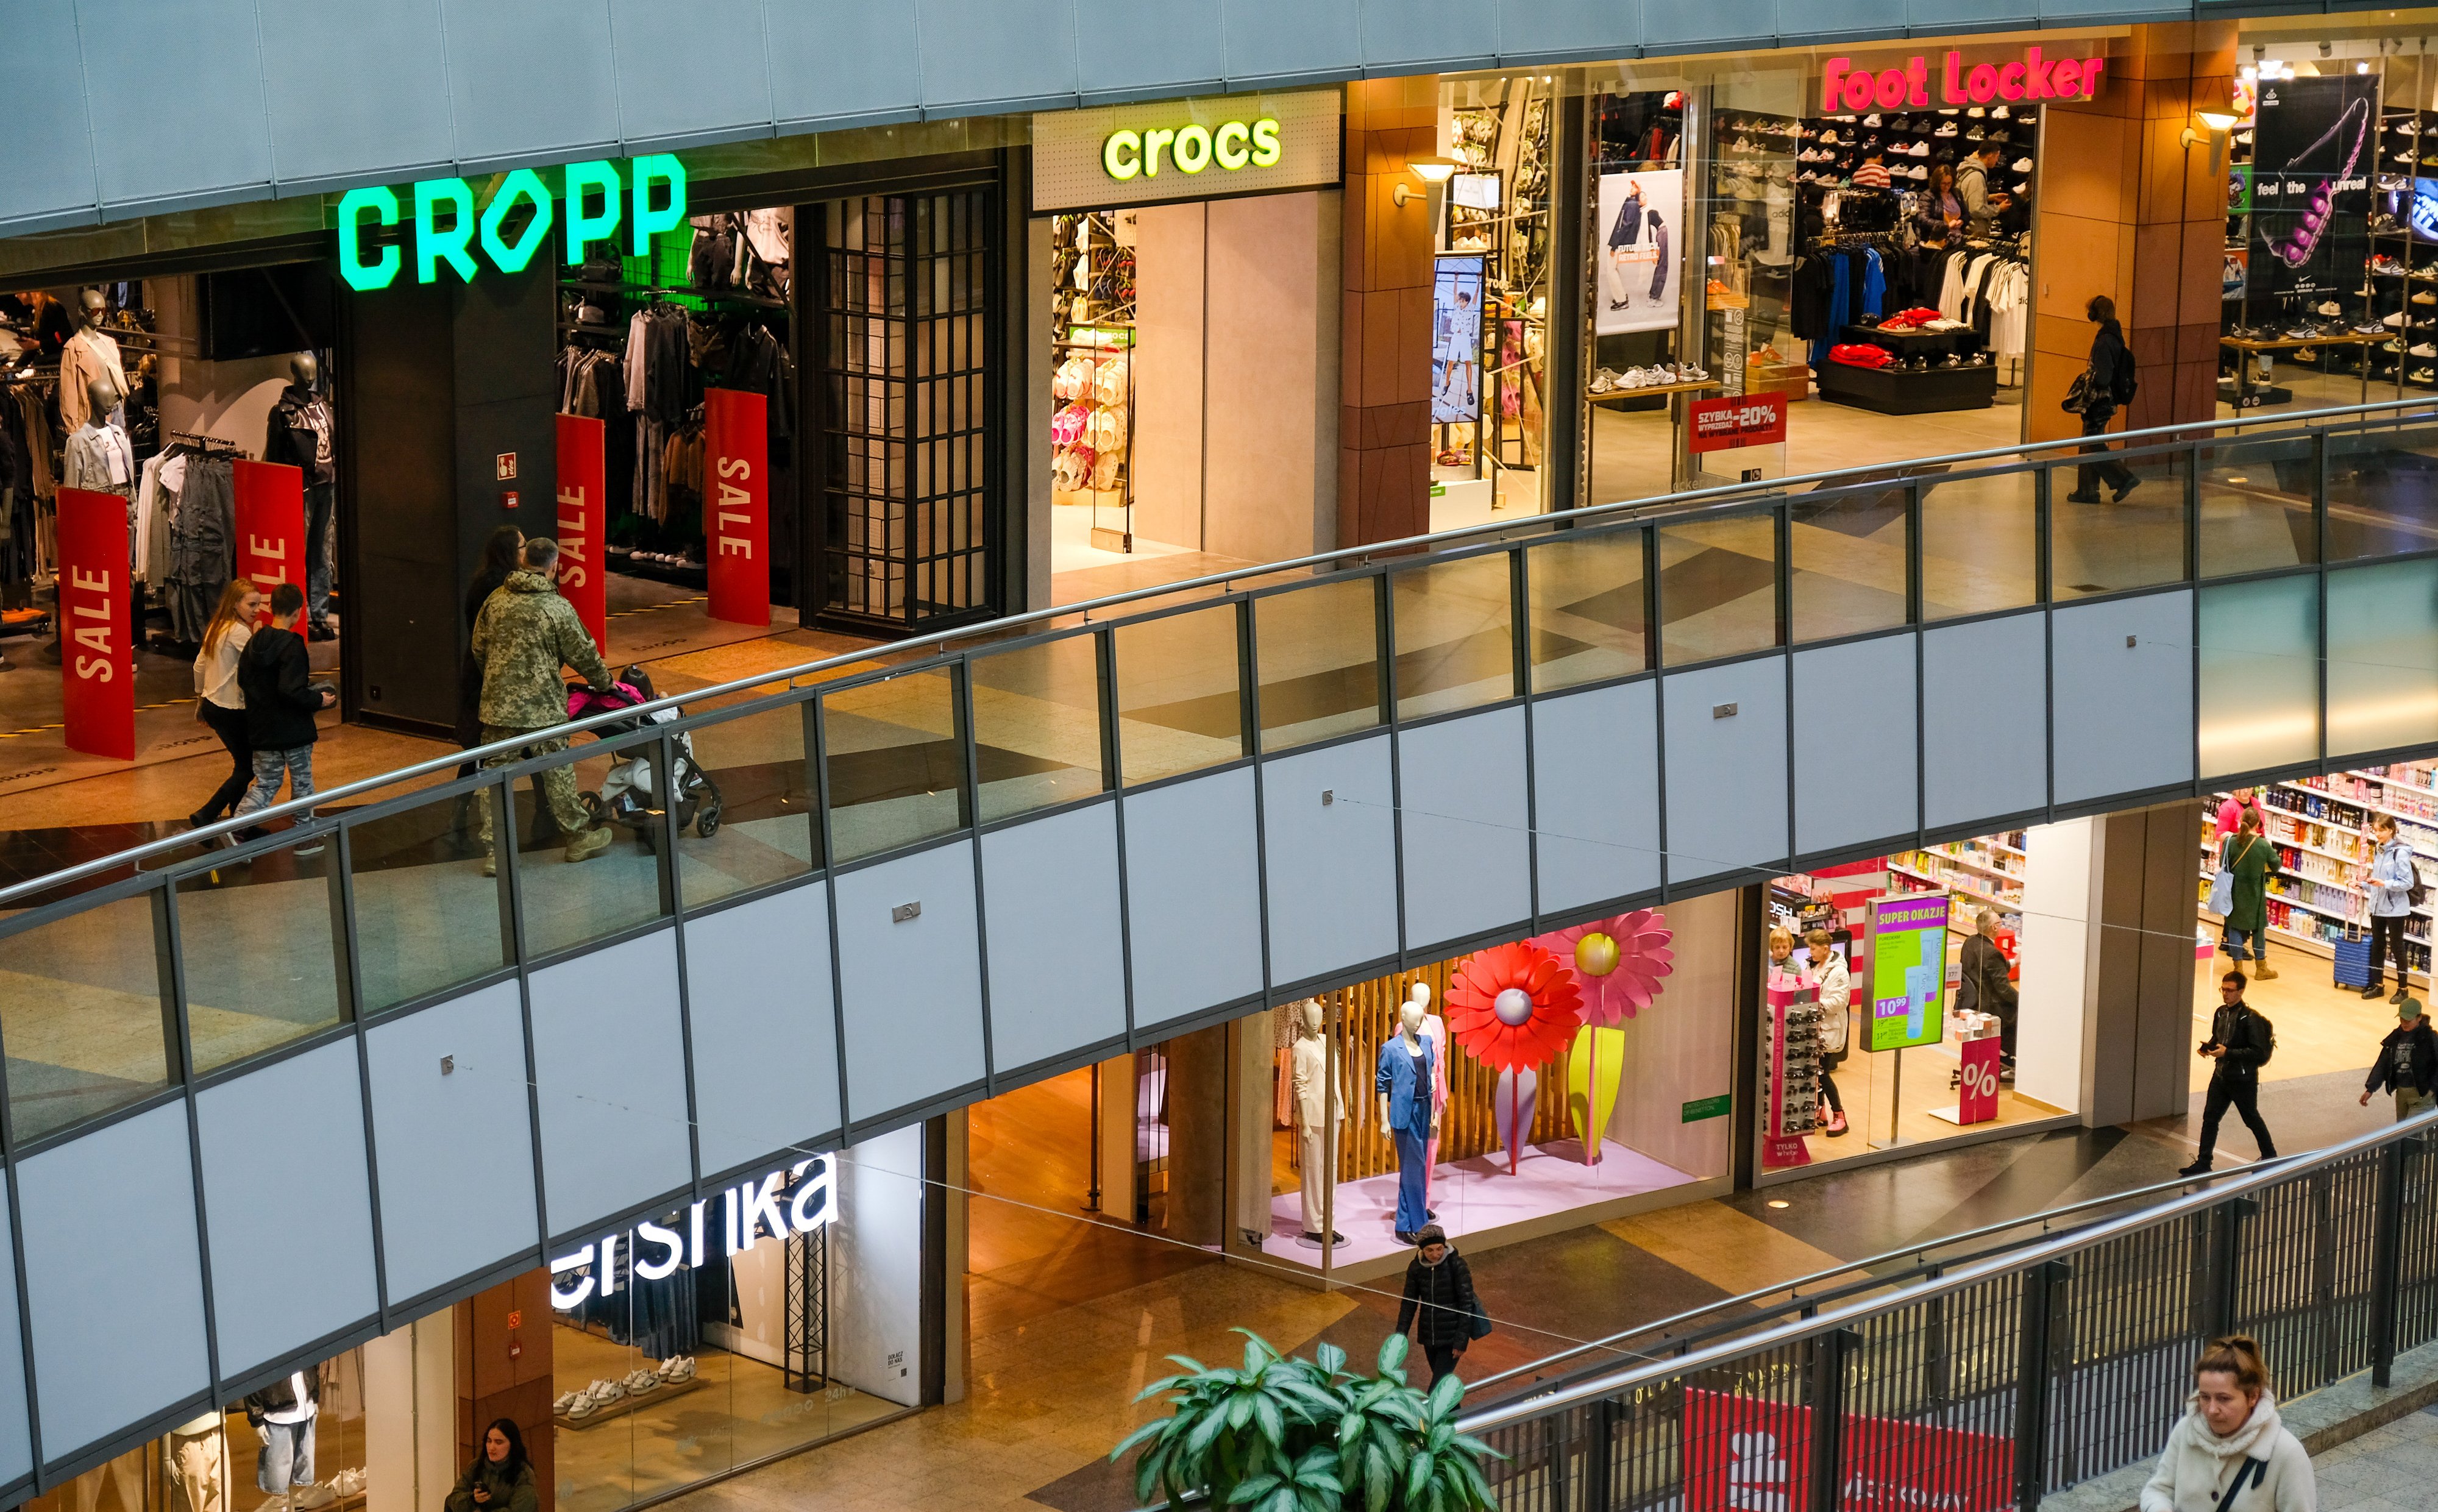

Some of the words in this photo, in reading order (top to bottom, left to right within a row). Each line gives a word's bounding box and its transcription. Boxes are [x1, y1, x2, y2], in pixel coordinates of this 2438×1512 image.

[1825, 57, 1928, 111] Foot
[1944, 46, 2103, 103] Locker
[1102, 118, 1281, 180] crocs
[2257, 182, 2279, 196] feel
[2287, 181, 2306, 194] the
[2333, 176, 2367, 191] unreal
[338, 153, 686, 291] CROPP
[1618, 252, 1639, 262] RETRO
[1698, 410, 1732, 424] SZYBKA
[1733, 405, 1777, 427] -20%
[1698, 430, 1708, 439] NA
[1709, 428, 1739, 438] WYBRANE
[1741, 424, 1773, 435] PRODUKTY
[717, 457, 752, 559] SALE
[557, 486, 586, 587] SALE
[250, 534, 286, 633] LE
[72, 565, 113, 683] SALE
[1770, 901, 1793, 917] OSH
[1879, 911, 1910, 925] SUPER
[1911, 906, 1946, 921] OKAZJE
[1963, 1060, 1996, 1100] %
